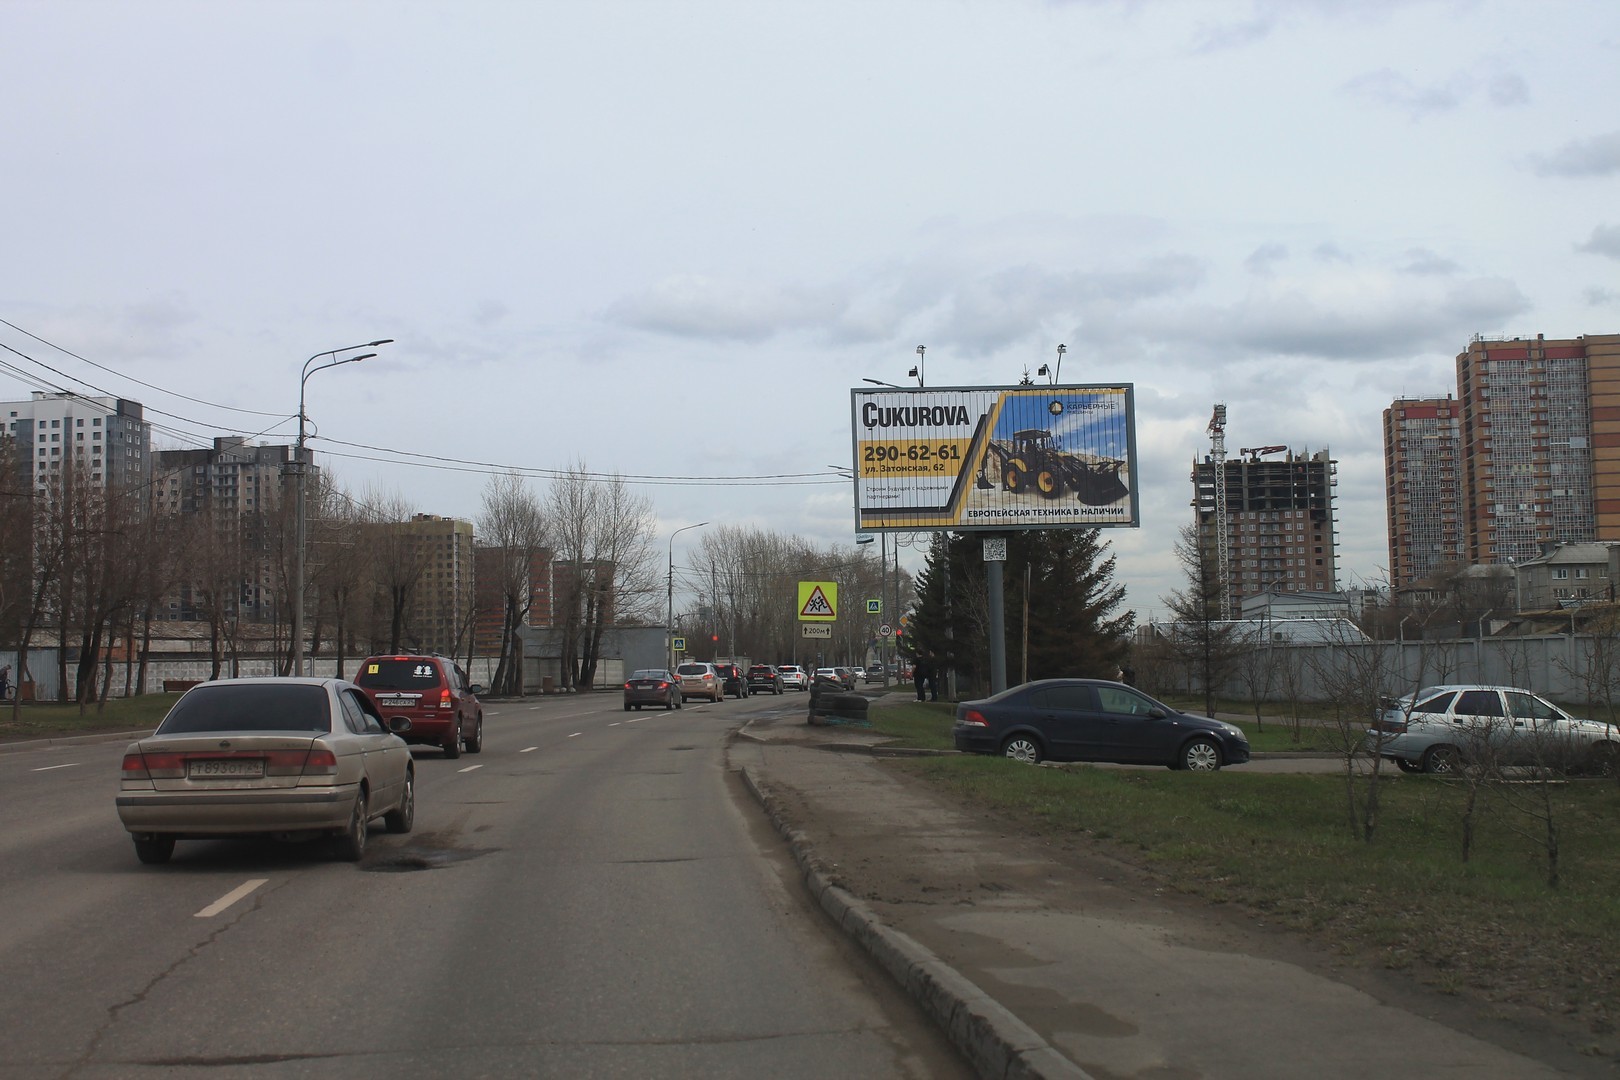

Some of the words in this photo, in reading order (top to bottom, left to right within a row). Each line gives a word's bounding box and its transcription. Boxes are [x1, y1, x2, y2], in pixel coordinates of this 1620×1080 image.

[864, 444, 960, 462] 290-62-61
[865, 466, 879, 475] ул.
[880, 464, 931, 473] Затонская,
[933, 463, 945, 471] 62
[968, 509, 1031, 518] ЕВРОПЕЙСКАЯ
[1032, 508, 1072, 517] ТЕХНИКА
[1074, 508, 1080, 516] В
[1081, 507, 1124, 516] НАЛИЧИИ
